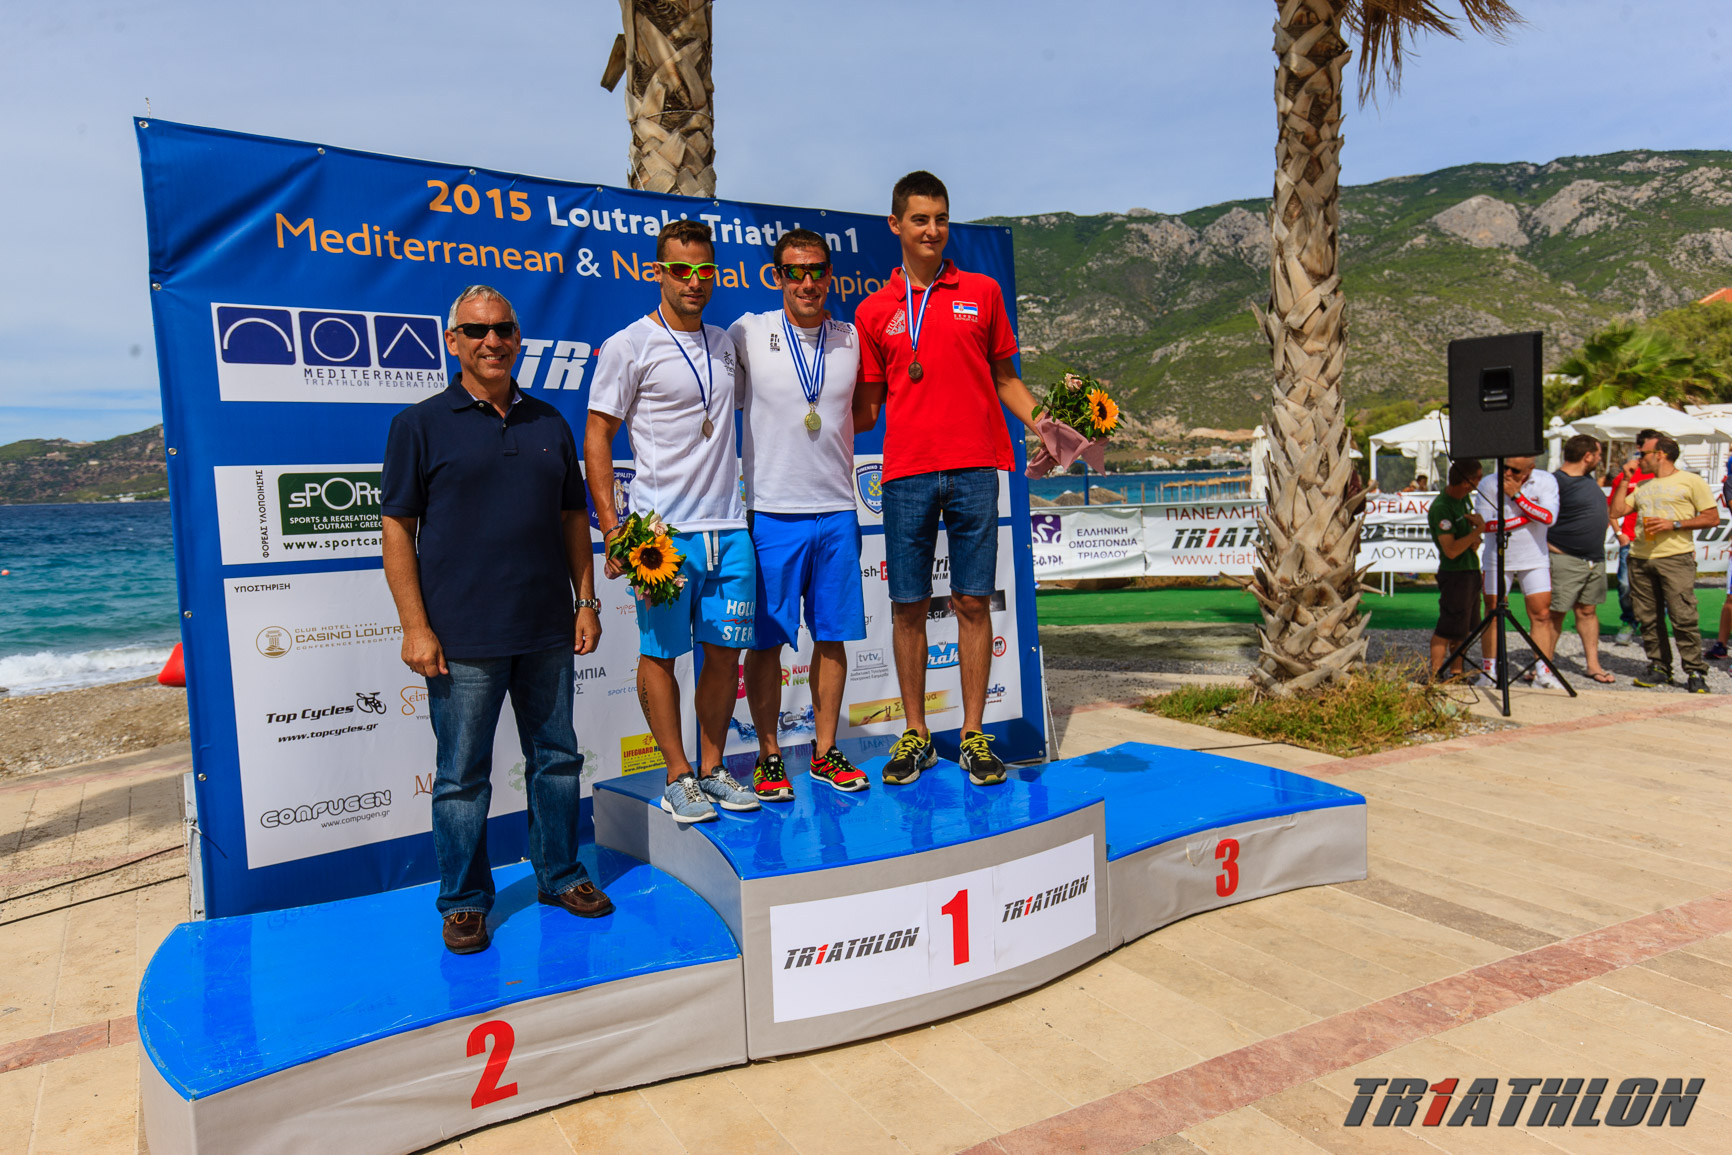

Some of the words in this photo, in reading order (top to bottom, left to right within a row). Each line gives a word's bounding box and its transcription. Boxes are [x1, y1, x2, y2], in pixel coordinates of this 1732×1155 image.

[427, 180, 532, 222] 2015
[547, 196, 689, 237] Loutra
[275, 213, 564, 274] Mediterranean
[576, 248, 602, 277] &
[304, 368, 445, 382] MEDITERRANEAN
[305, 379, 370, 387] TRIATHLON
[255, 470, 266, 524] ΥΛΟΠΟΙΗΣΗΣ
[289, 516, 319, 524] SPORTS
[313, 523, 353, 531] LOUTRAKI
[1077, 527, 1128, 537] ΕΛΛΗΝΙΚΗ
[1383, 525, 1431, 538] ΣΕΠΤ
[261, 526, 270, 558] ΦΟΡΕΑΣ
[1069, 538, 1137, 549] ΟΜΟΣΠΟΝΔΙΑ
[1078, 550, 1128, 559] ΤΡΙΑΘΛΟΥ
[234, 583, 291, 593] ΥΠΟΣΤΗΡΙΞΗ
[295, 630, 352, 643] CASINO
[296, 641, 352, 650] CONFERENCE
[266, 712, 297, 724] Top
[301, 705, 354, 721] Cycles
[278, 722, 379, 743] www.topcycles.gr
[321, 809, 390, 829] www.compugen.gr
[1215, 838, 1240, 897] 3
[784, 927, 920, 970] TR1ATHLON
[941, 889, 969, 966] 1
[1002, 875, 1090, 923] TR1ATHLON
[466, 1020, 518, 1109] 2
